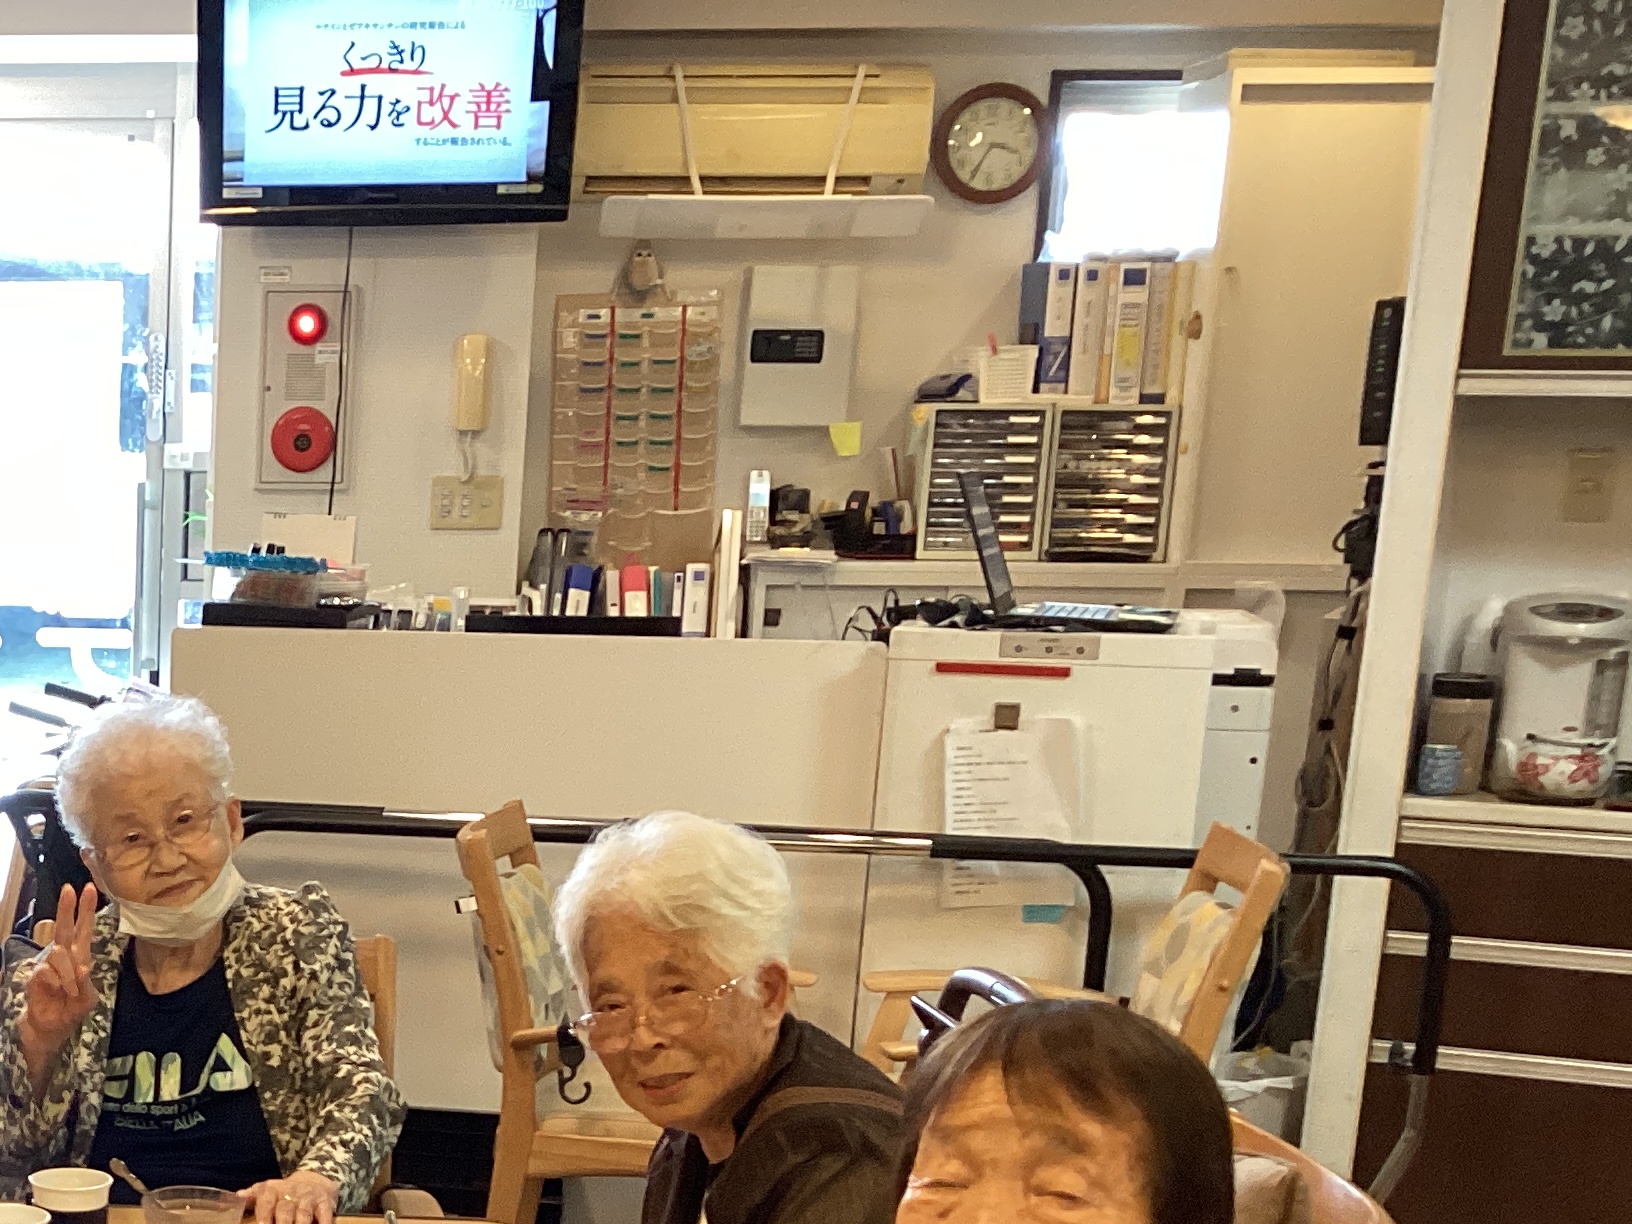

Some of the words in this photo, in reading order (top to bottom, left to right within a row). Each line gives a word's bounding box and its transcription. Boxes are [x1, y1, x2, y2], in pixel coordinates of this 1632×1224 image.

[342, 40, 427, 71] くっきり
[265, 82, 512, 134] 見る力を改善
